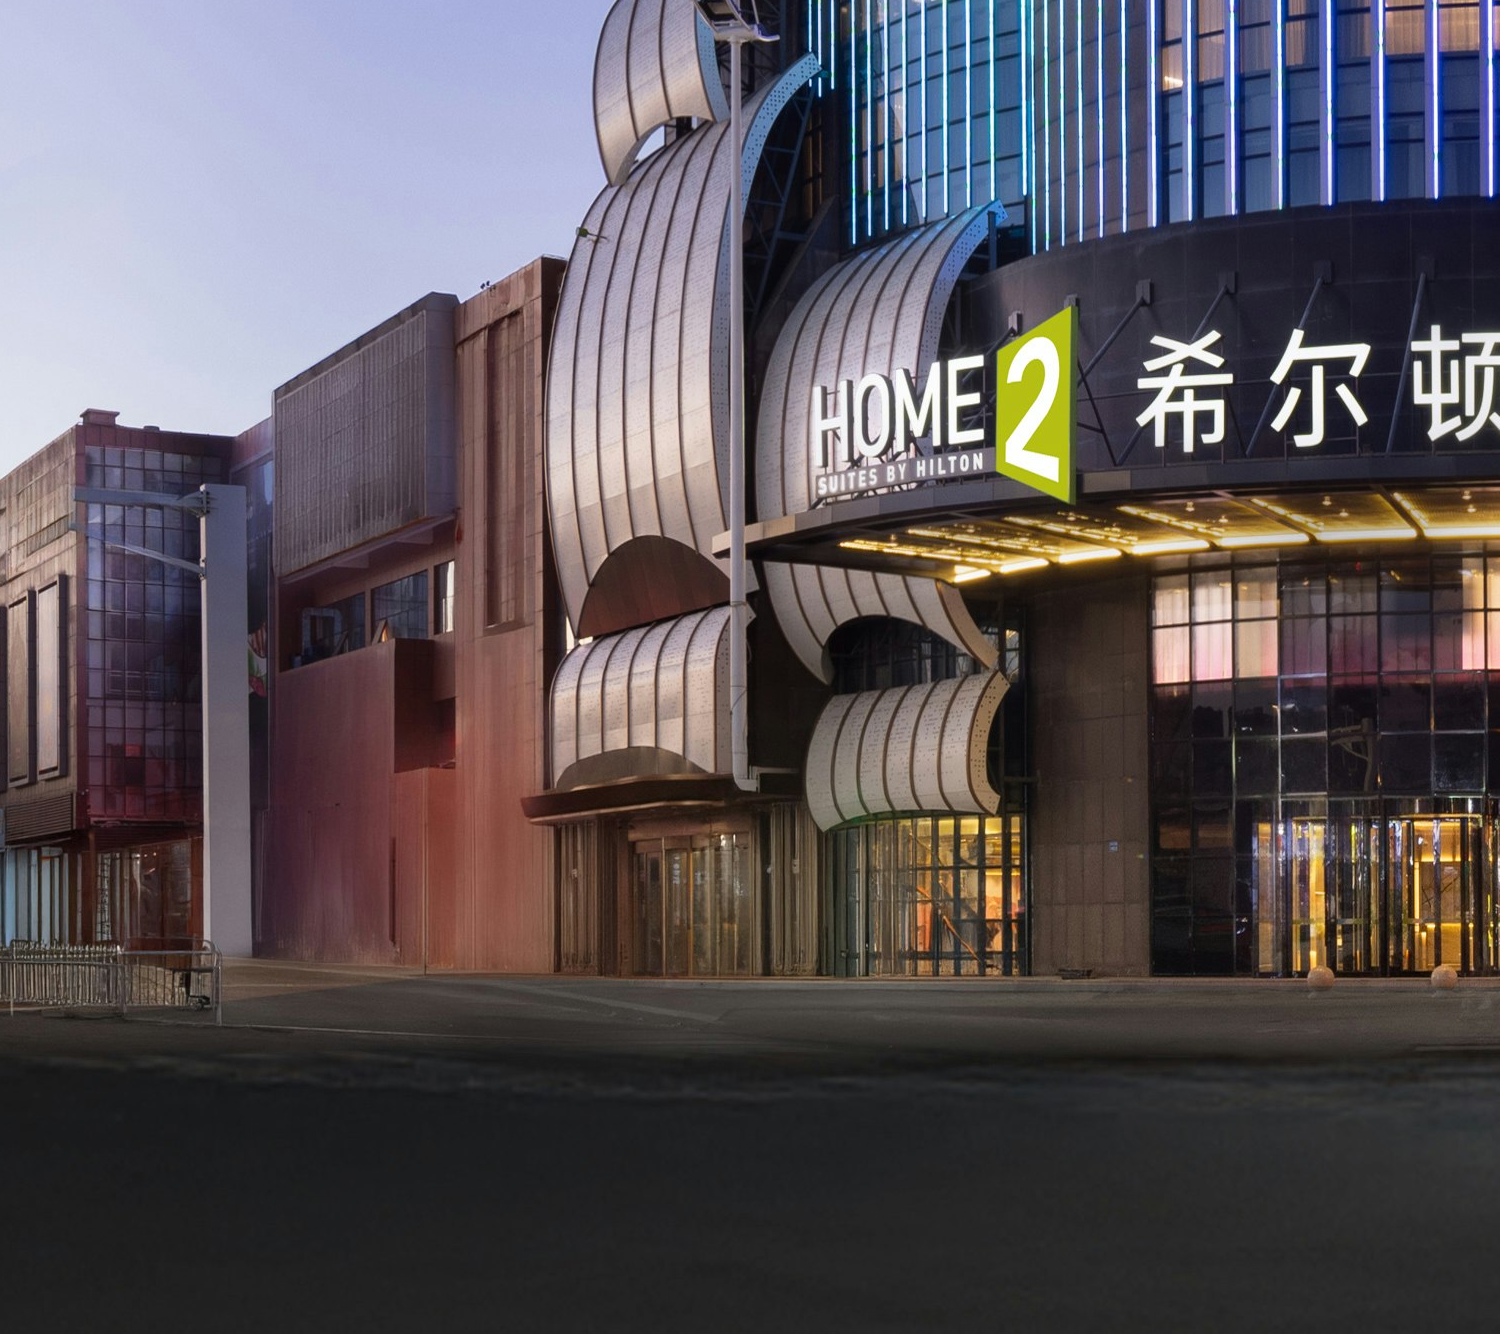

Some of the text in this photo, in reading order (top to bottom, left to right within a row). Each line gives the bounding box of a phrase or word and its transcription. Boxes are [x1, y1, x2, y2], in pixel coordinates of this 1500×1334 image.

[812, 354, 985, 468] HOME
[817, 452, 984, 495] SUITES BY HILTON
